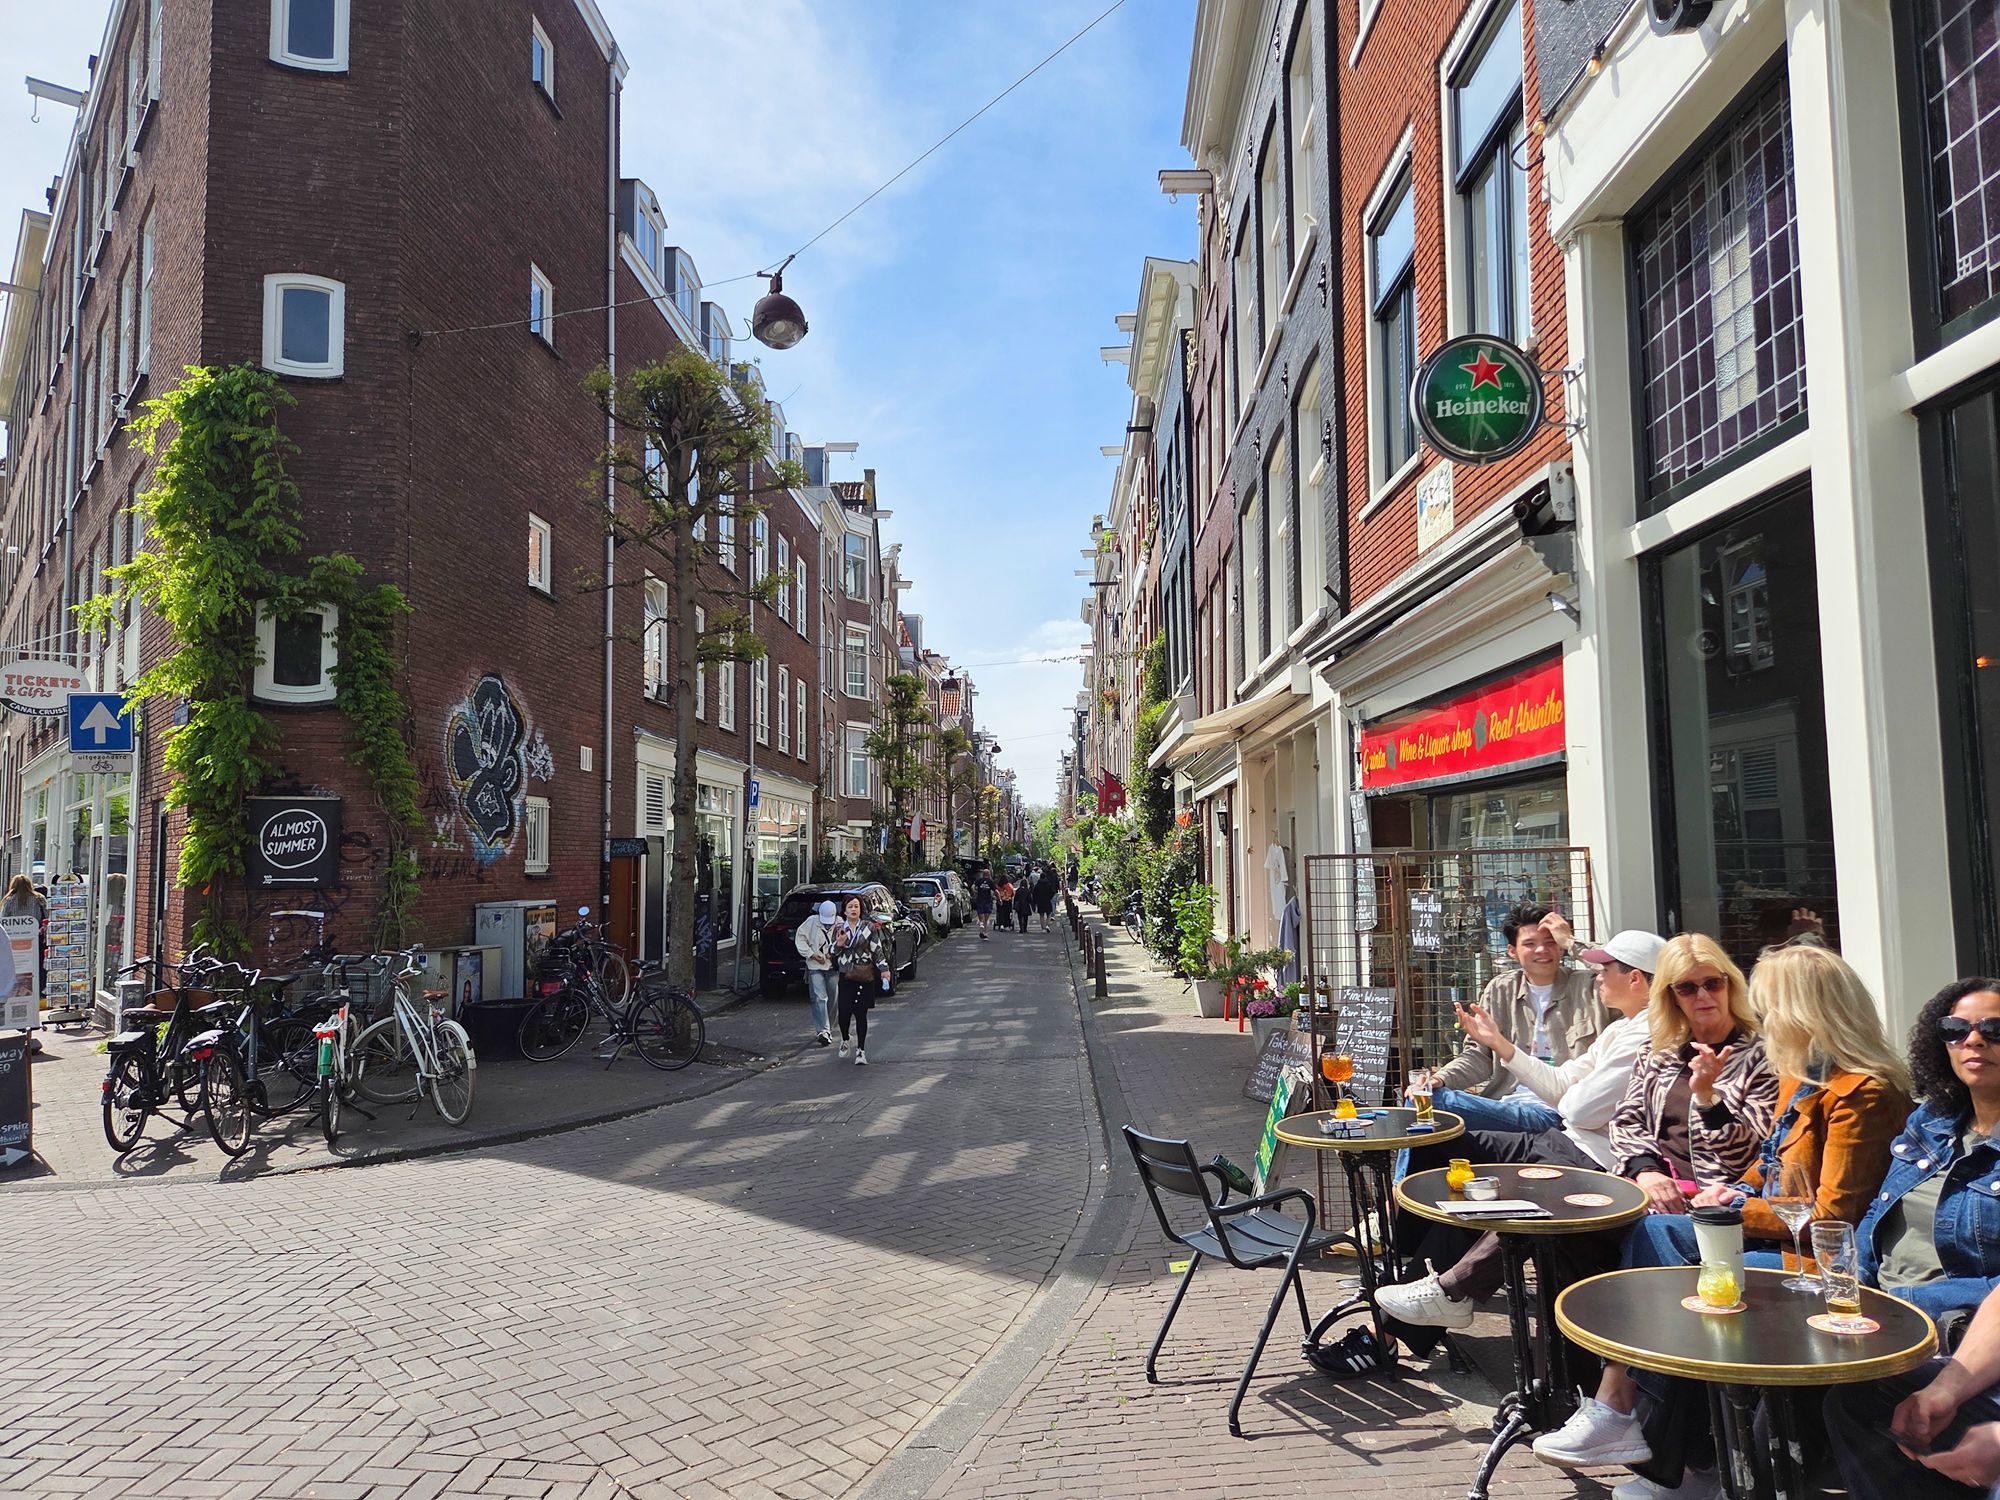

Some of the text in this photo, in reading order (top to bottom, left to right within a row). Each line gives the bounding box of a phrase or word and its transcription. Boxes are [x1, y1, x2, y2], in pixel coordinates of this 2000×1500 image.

[1436, 395, 1529, 418] Heineken
[5, 674, 81, 689] TICKETS
[5, 686, 16, 696] &
[9, 702, 38, 715] CANAL
[1488, 688, 1564, 743] Real Absinthe
[1399, 737, 1418, 763] Wine
[1418, 733, 1425, 760] &
[1424, 732, 1451, 766] Liquor
[1451, 720, 1473, 758] shop
[751, 783, 758, 804] P
[270, 820, 320, 837] ALMOST
[265, 838, 317, 855] SUMMER
[0, 917, 34, 928] RINKS
[1343, 989, 1390, 1004] Fine Wines
